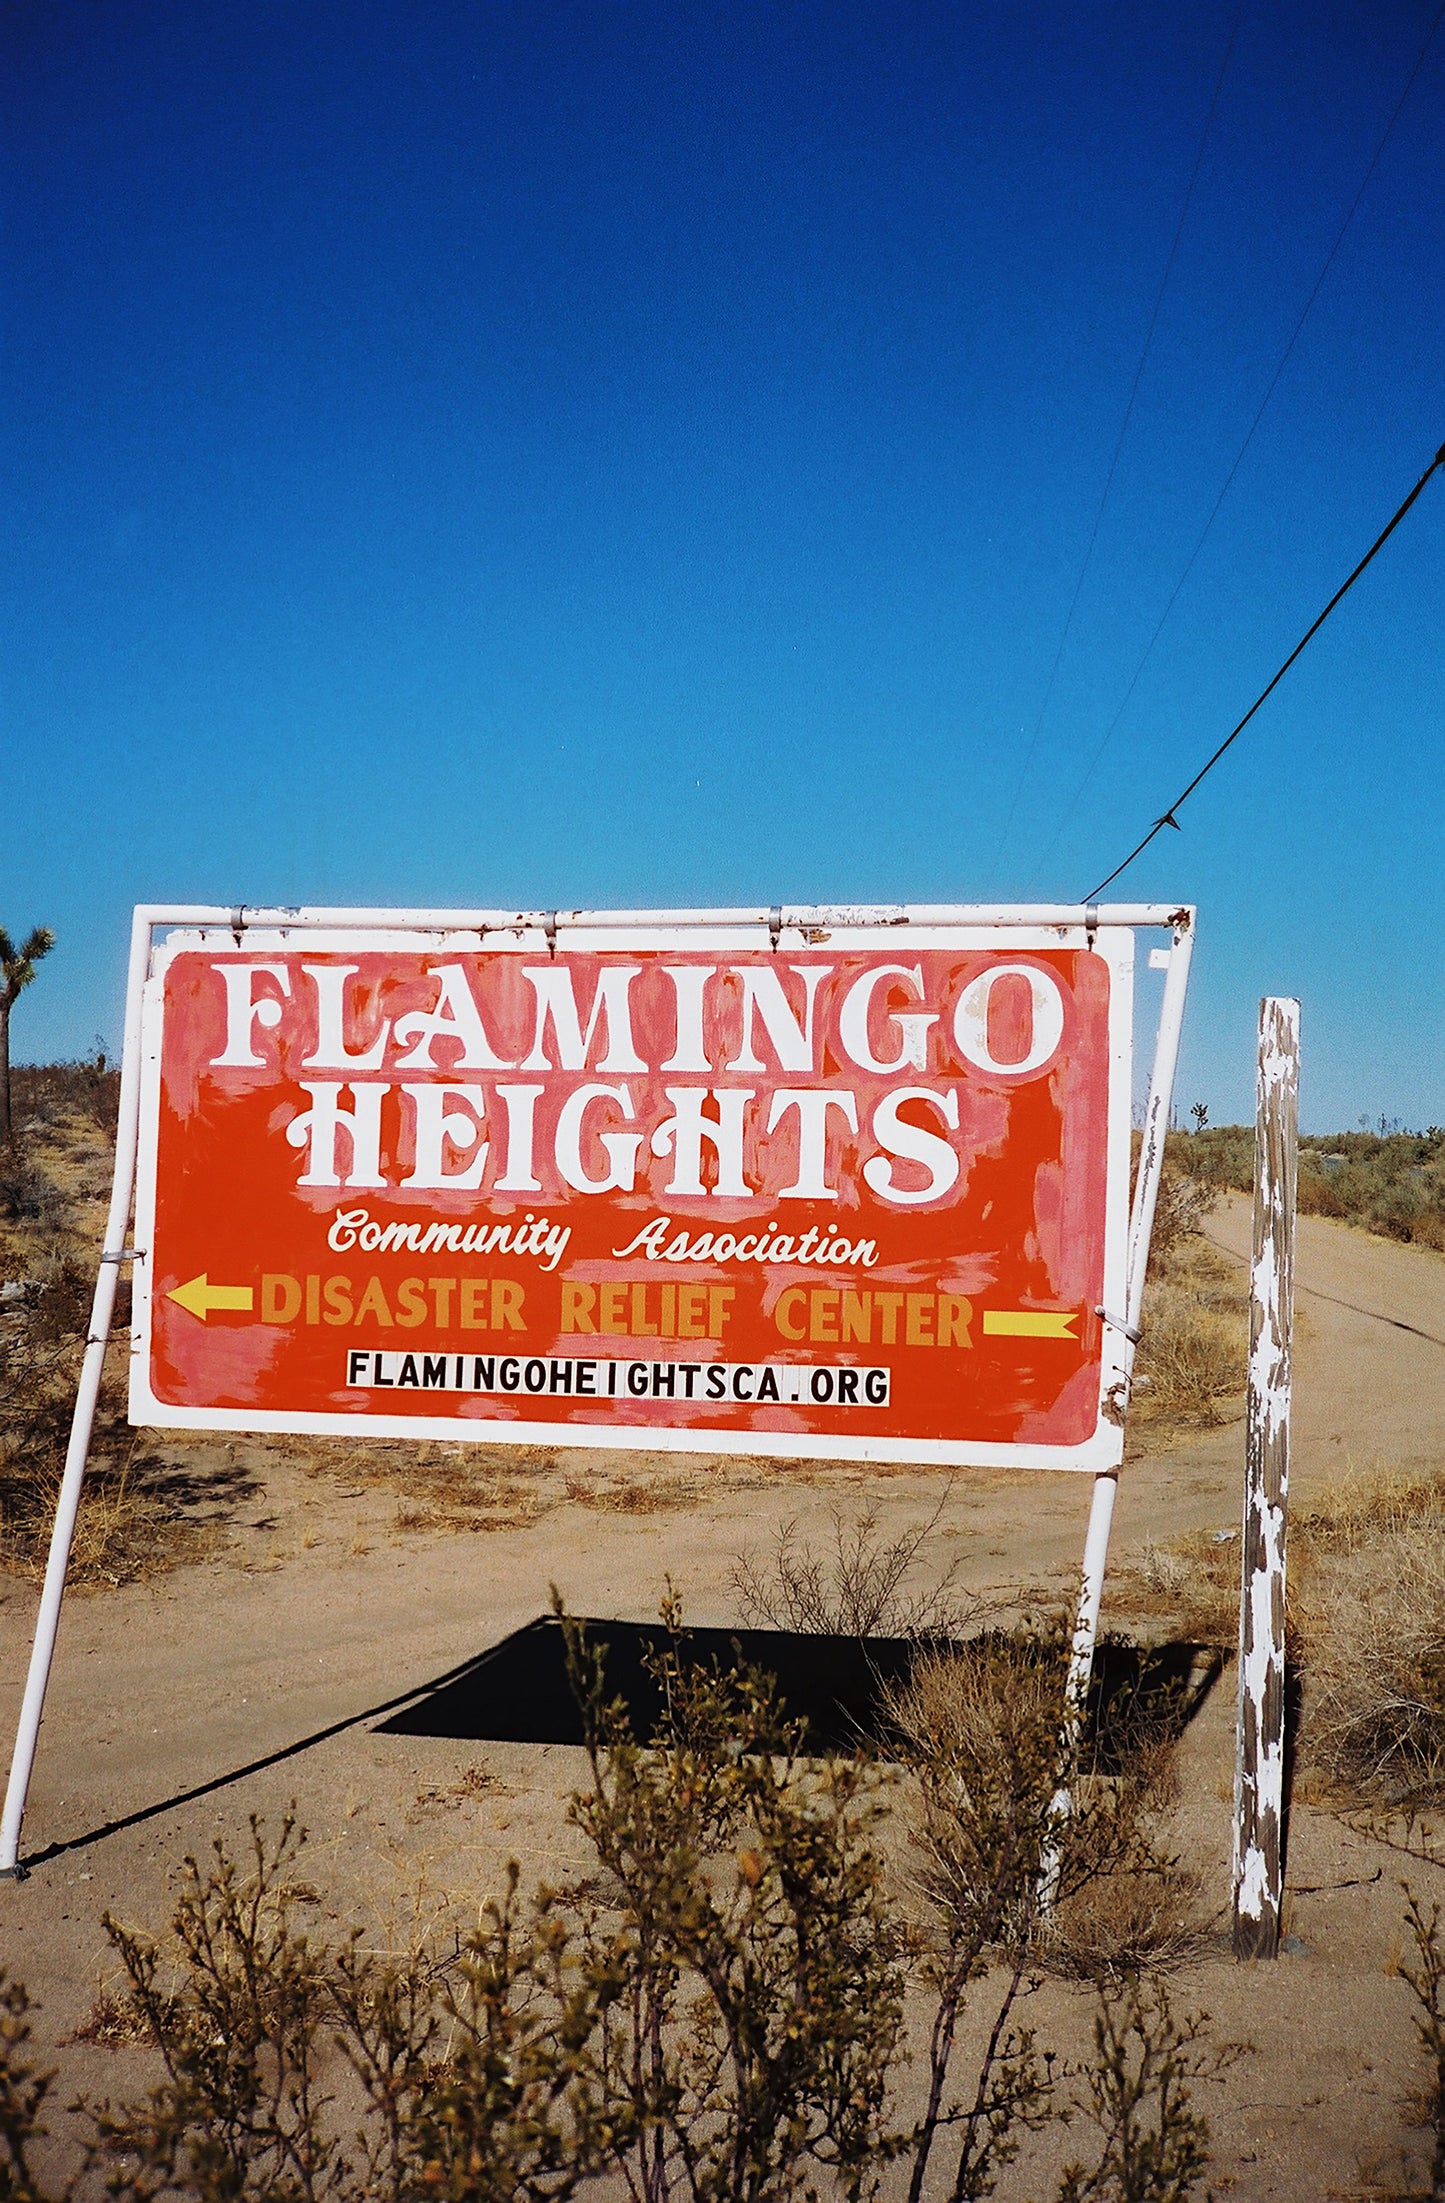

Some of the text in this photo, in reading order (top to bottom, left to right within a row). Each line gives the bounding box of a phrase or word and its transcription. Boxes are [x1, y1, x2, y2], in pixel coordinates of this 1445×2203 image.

[210, 962, 1064, 1075] FLAMINGO
[286, 1081, 959, 1205] HEIGHTS
[327, 1208, 880, 1271] Community Association
[261, 1273, 974, 1348] DISASTER RELIEF CENTER
[348, 1351, 889, 1405] FLAMINGOHEIGHTSCA.ORG
